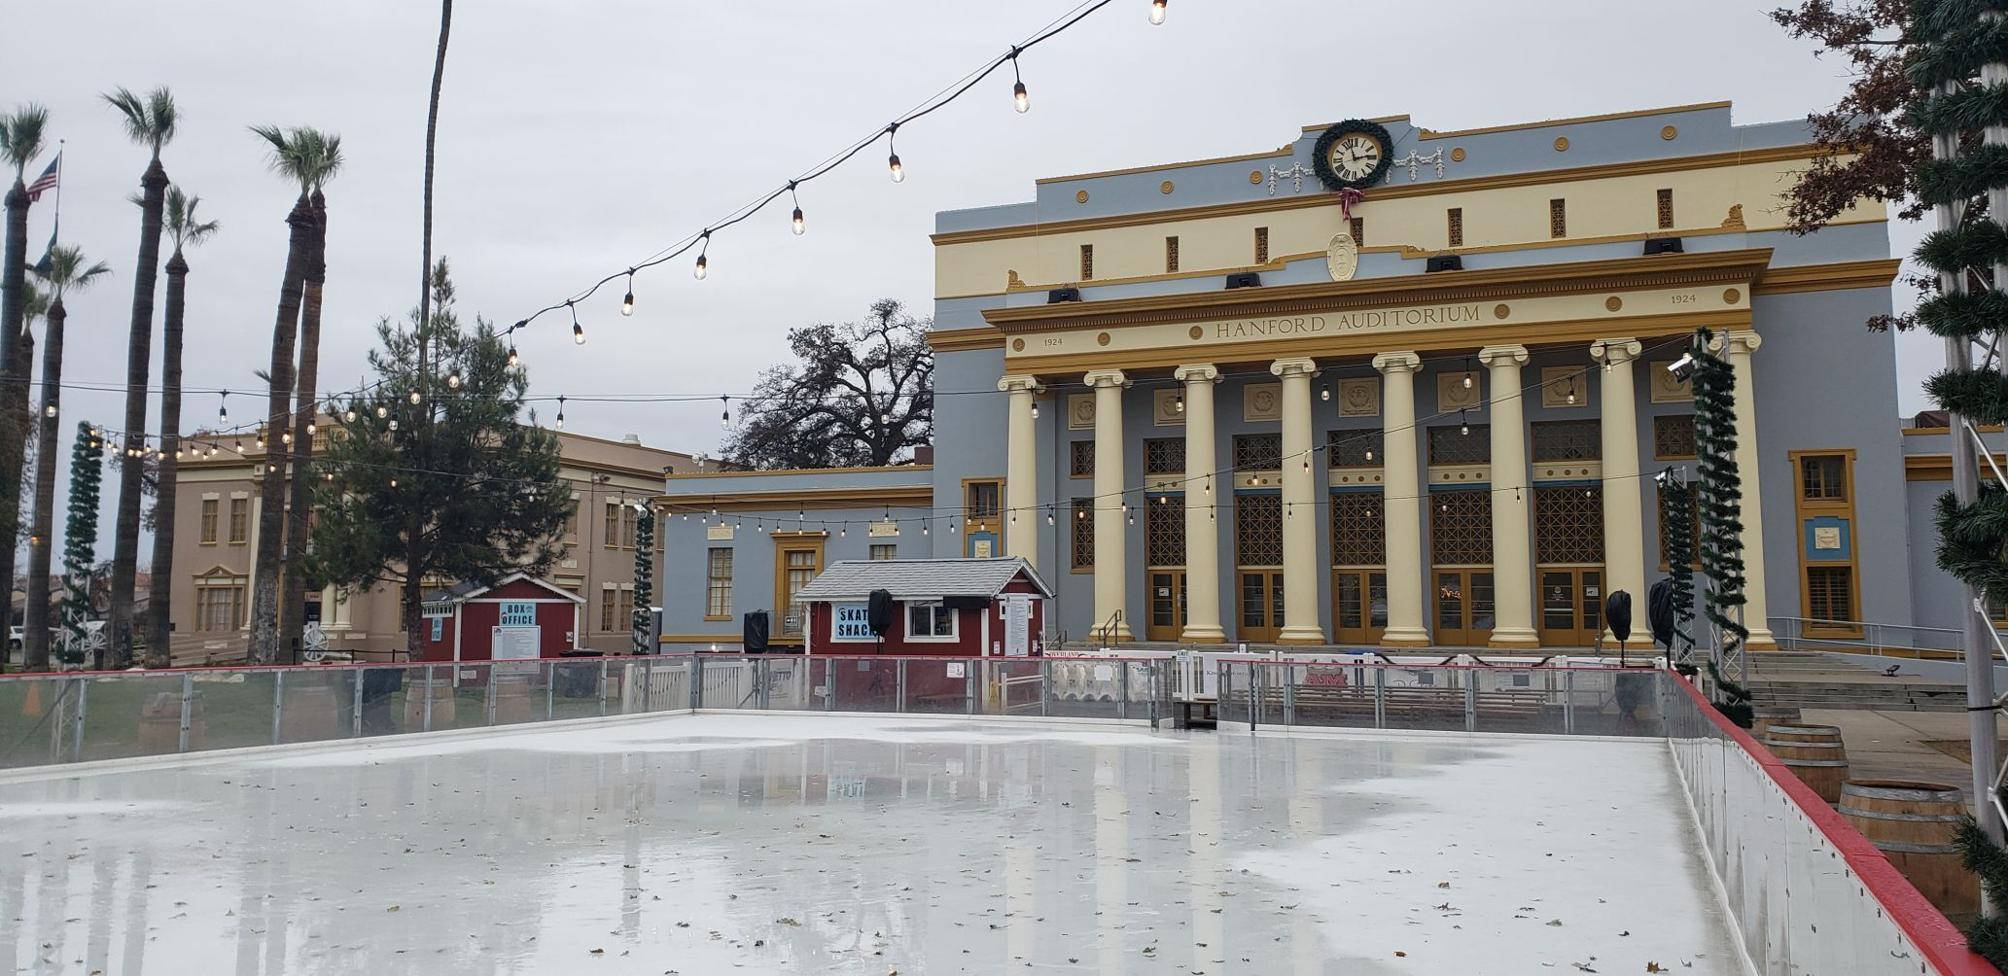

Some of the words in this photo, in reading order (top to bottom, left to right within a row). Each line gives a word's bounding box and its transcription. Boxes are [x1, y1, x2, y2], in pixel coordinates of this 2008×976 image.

[1671, 294, 1697, 304] 1924
[1216, 316, 1326, 338] HANFORD
[1338, 305, 1480, 330] AUDITORIUM
[1044, 338, 1063, 347] 1924
[507, 604, 525, 614] BOX
[840, 609, 868, 621] SKAT
[502, 616, 533, 625] OFFICE
